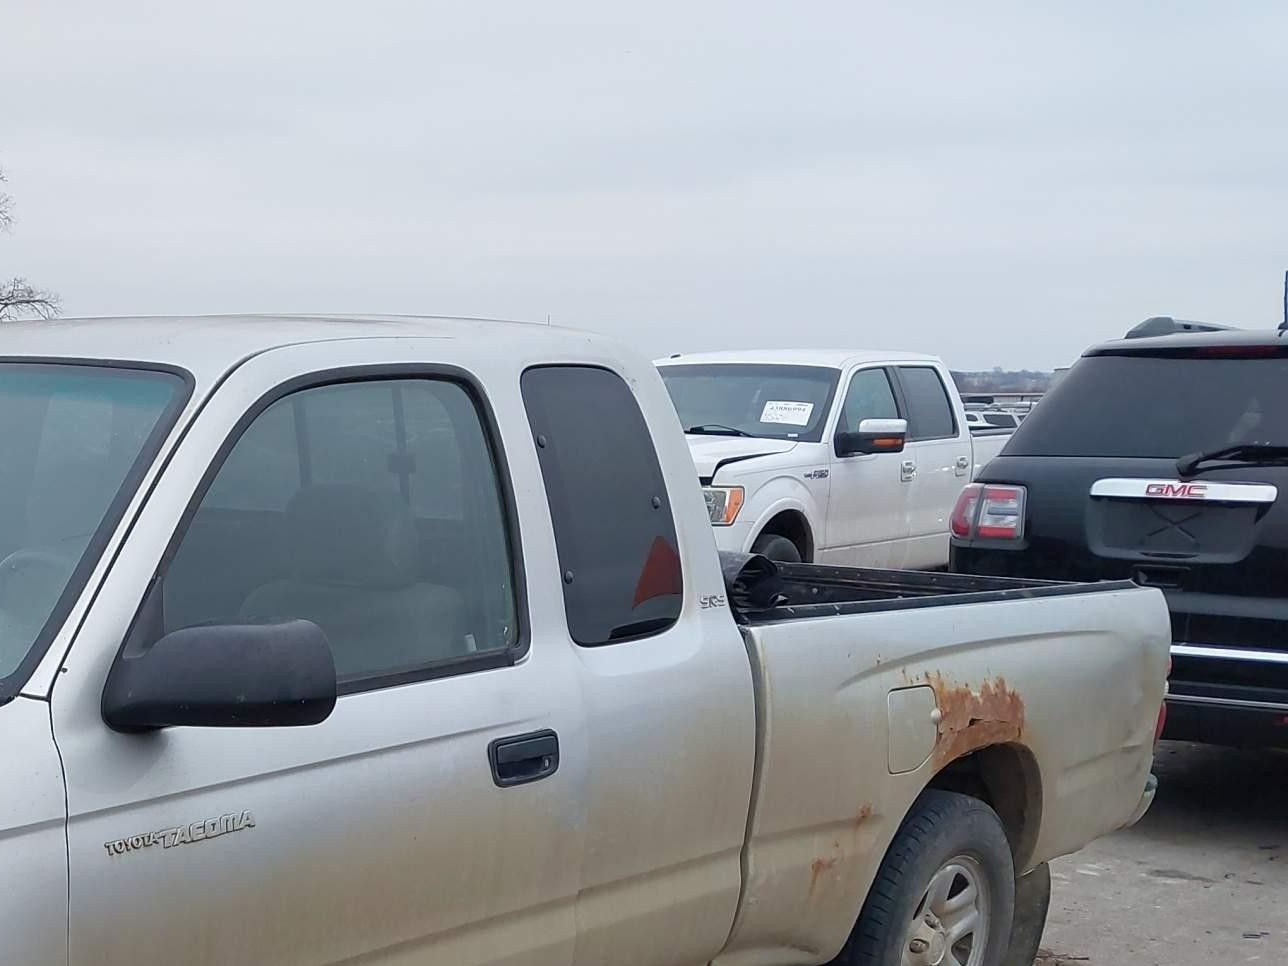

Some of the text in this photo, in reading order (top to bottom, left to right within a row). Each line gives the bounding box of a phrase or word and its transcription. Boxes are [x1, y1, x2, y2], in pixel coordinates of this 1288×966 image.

[1146, 484, 1208, 497] GMC
[104, 809, 256, 856] TOYOTA TACOMA
